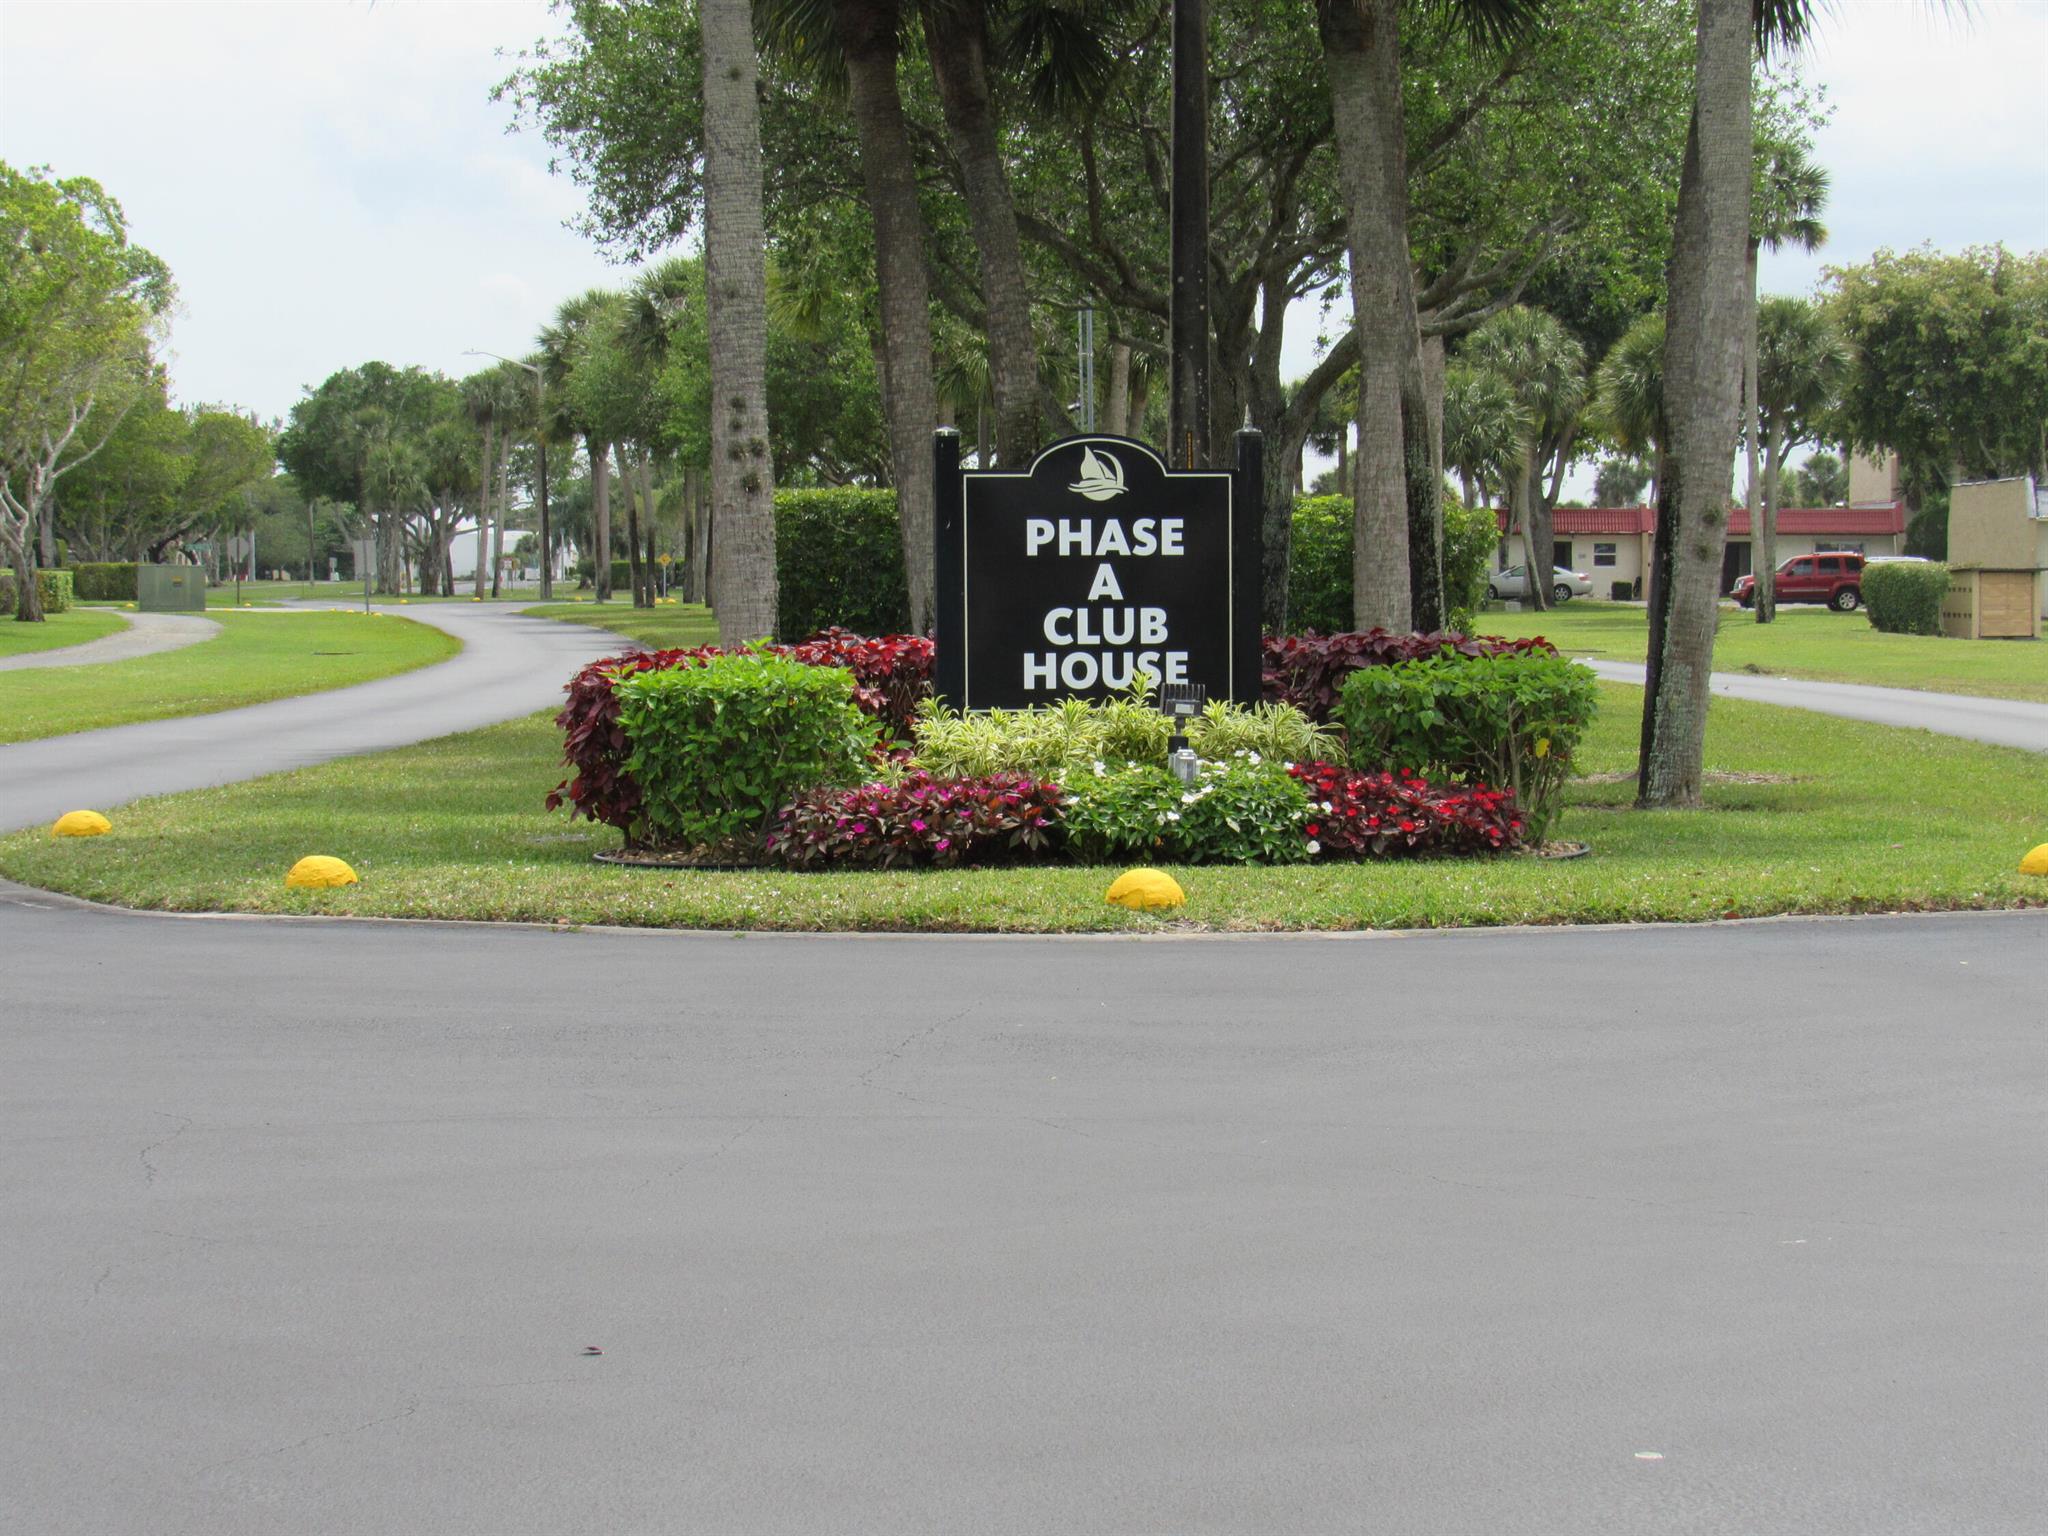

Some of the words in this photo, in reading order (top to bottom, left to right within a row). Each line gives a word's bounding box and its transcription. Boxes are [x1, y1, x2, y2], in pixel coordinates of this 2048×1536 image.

[1027, 519, 1184, 556] PHASE
[1088, 564, 1123, 600] A
[1044, 608, 1168, 645] CLUB
[1024, 652, 1188, 690] HOUSE
